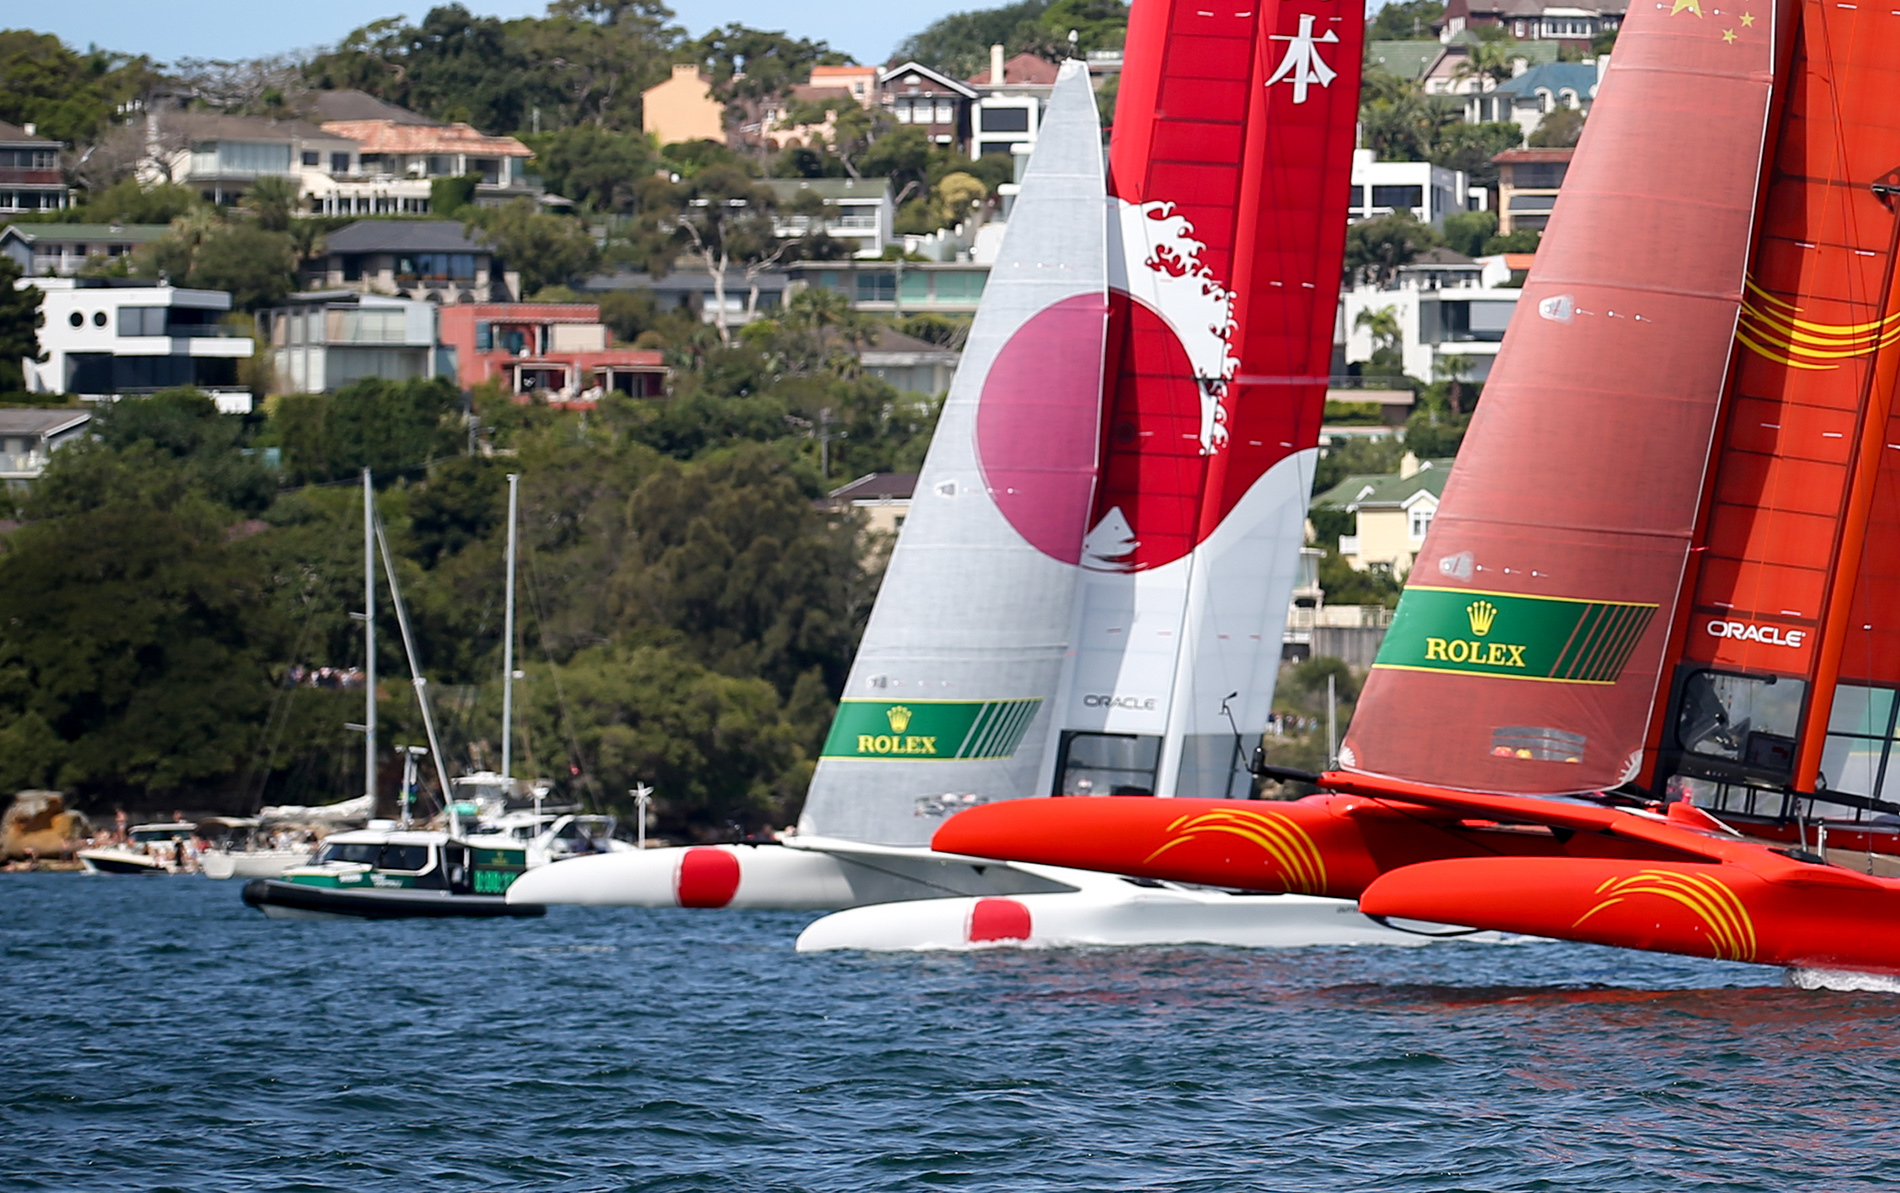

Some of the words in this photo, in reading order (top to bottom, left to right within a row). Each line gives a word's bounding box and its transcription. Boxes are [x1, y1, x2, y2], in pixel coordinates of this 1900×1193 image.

[1706, 619, 1803, 648] ORACLE
[1424, 636, 1527, 669] ROLEX
[1083, 693, 1158, 711] ORACLE
[857, 734, 937, 754] ROLEX
